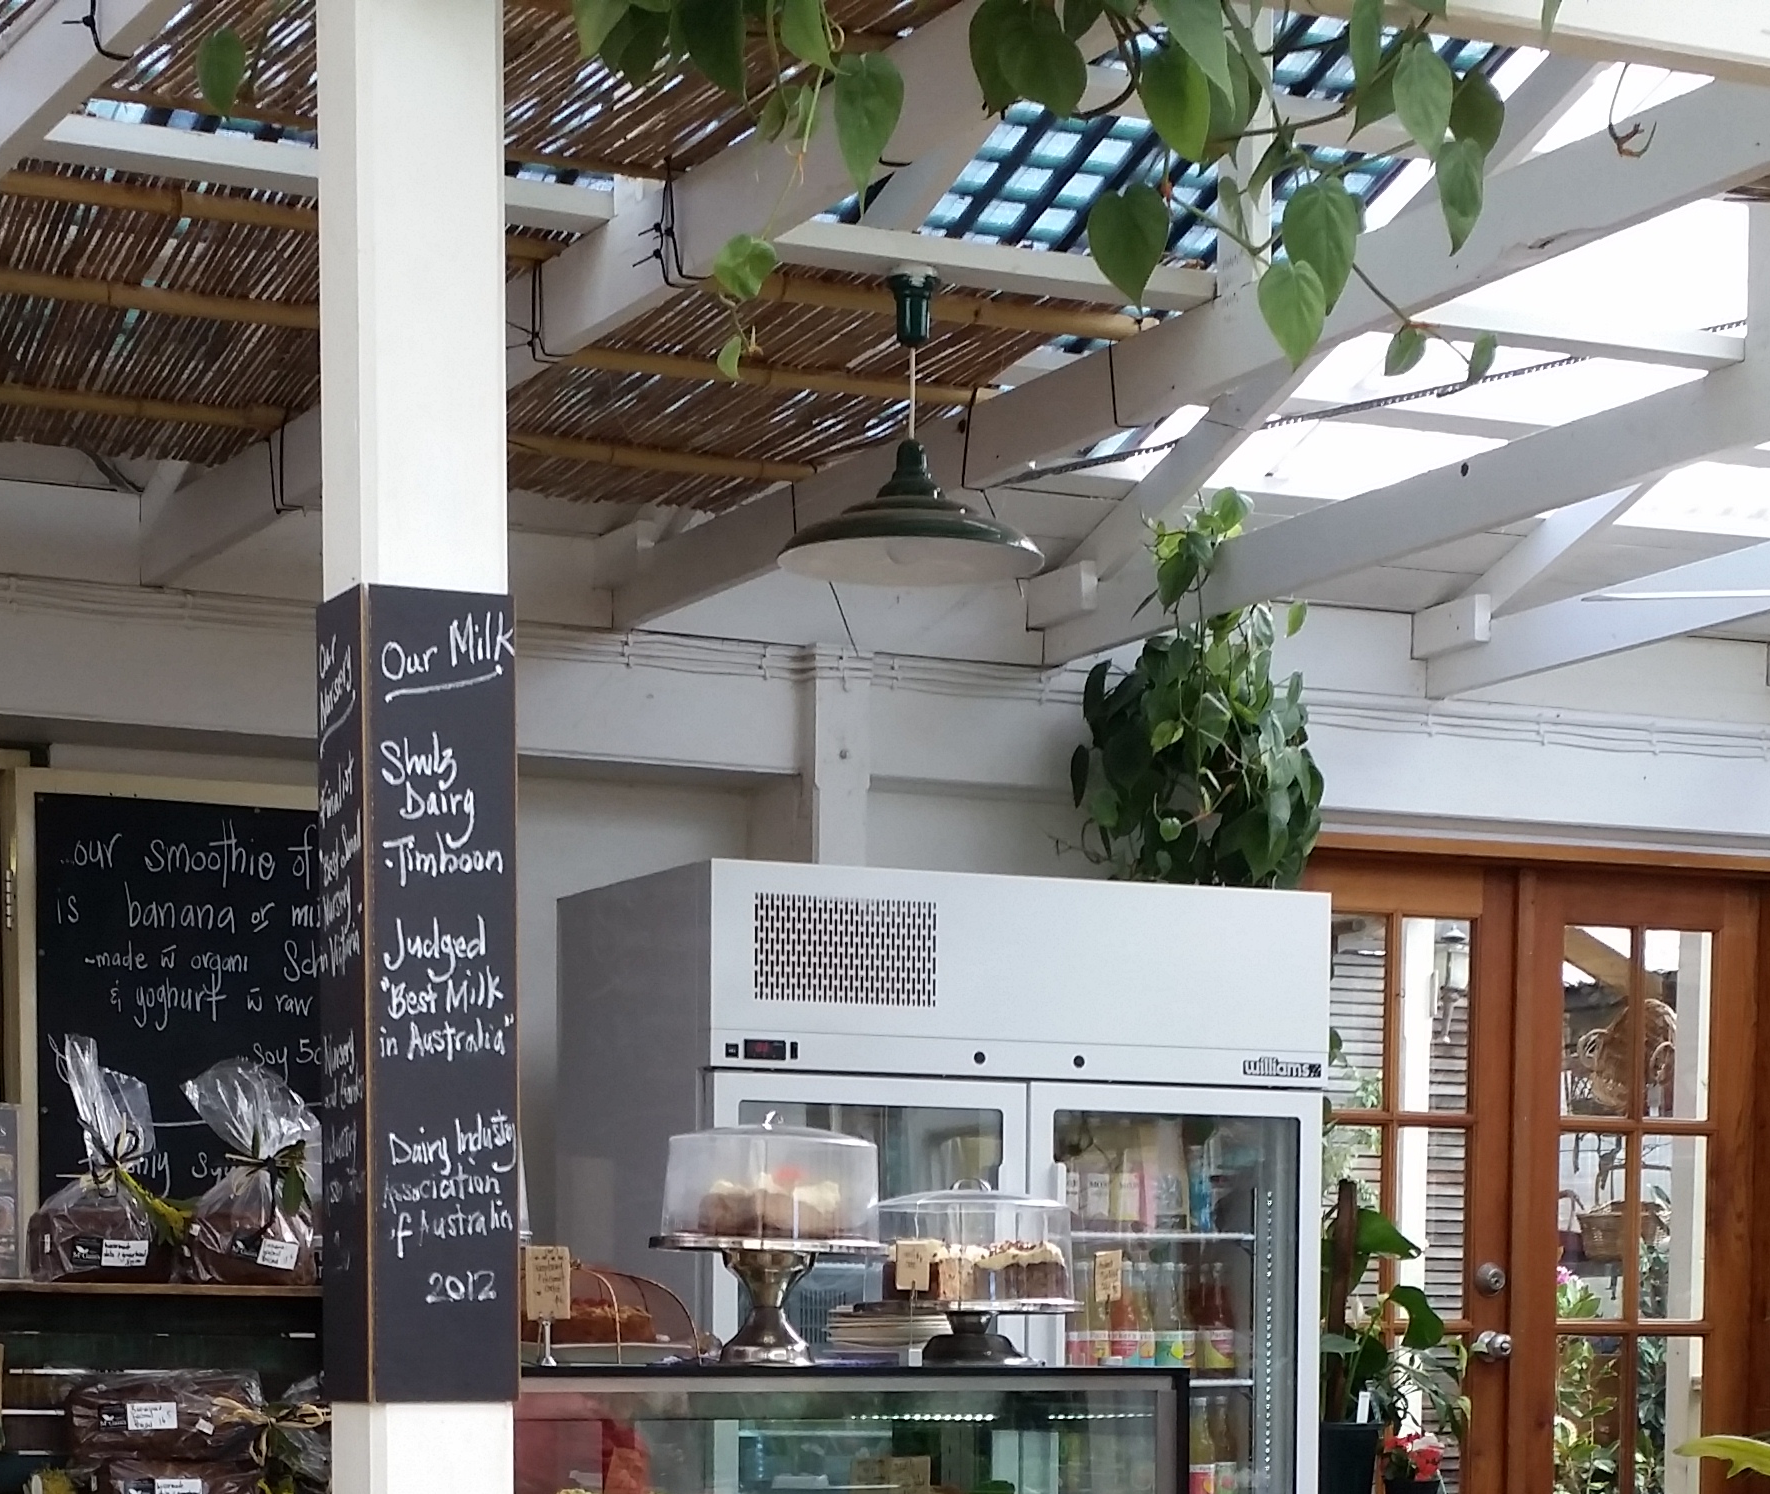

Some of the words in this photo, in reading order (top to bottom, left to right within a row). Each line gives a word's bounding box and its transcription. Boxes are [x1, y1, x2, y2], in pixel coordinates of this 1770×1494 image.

[319, 634, 337, 680] Our
[381, 641, 438, 681] Our
[449, 611, 516, 668] Milk
[320, 750, 355, 829] Finalist
[399, 781, 476, 850] Dairy
[287, 824, 317, 890] of
[56, 886, 80, 925] is
[124, 880, 235, 935] banana
[250, 902, 275, 933] or
[384, 914, 486, 983] Judged
[133, 973, 227, 1031] yoghurt
[275, 994, 314, 1017] raw
[446, 965, 504, 1015] Milk
[379, 1026, 398, 1058] in
[1244, 1056, 1311, 1078] williams
[389, 1127, 451, 1177] Dairy
[426, 1269, 498, 1304] 2012
